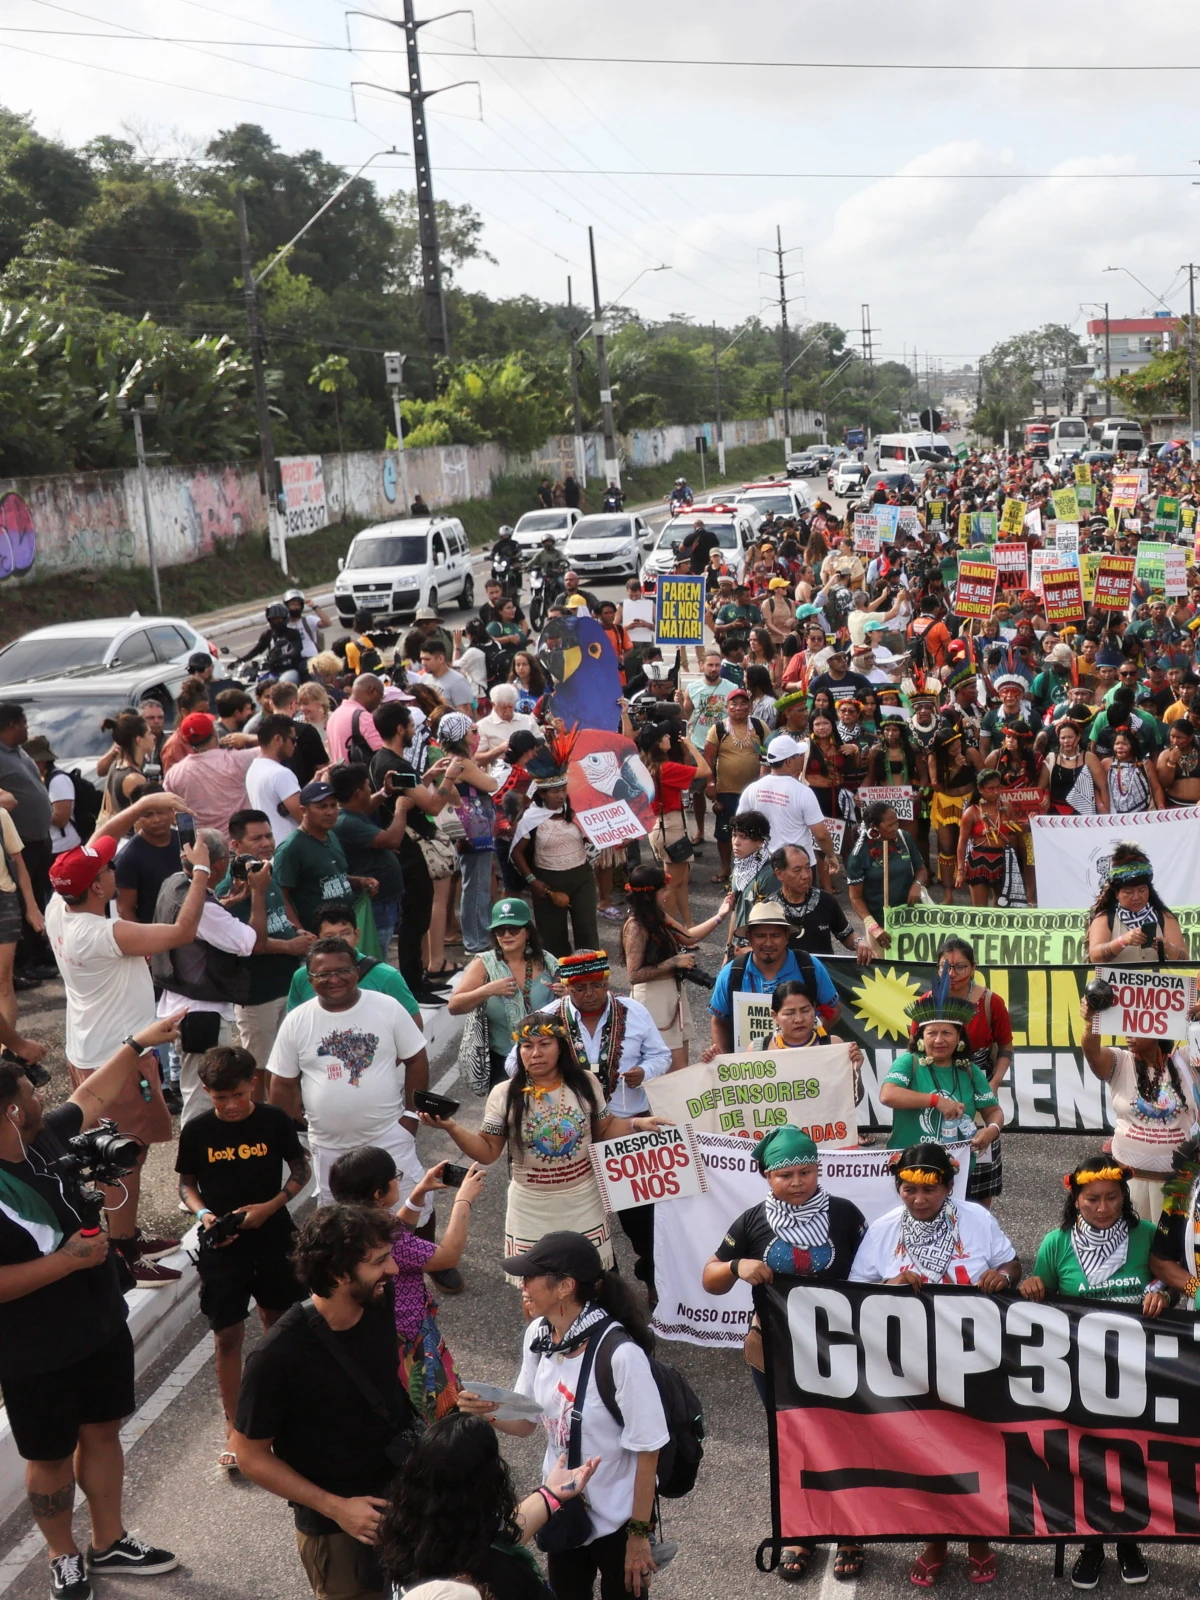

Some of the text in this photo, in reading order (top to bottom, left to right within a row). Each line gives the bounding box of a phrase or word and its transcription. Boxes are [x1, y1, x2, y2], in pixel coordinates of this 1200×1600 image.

[1114, 486, 1136, 495] WE ARE
[1060, 506, 1076, 516] IS US
[1163, 502, 1176, 512] WE
[1154, 518, 1178, 526] NATURE
[1058, 542, 1077, 550] SOMOS
[995, 550, 1026, 564] MAKE
[960, 564, 996, 580] CLIMATE
[1101, 559, 1134, 572] CLIMATE
[998, 571, 1024, 589] PAY
[1043, 571, 1080, 585] CLIMATE
[1137, 568, 1165, 580] GENTE
[960, 582, 992, 597] WE ARE
[1098, 576, 1130, 589] WE ARE
[662, 582, 701, 601] PAREM
[970, 595, 979, 603] THE
[1046, 588, 1079, 601] WE ARE
[956, 602, 991, 615] ANSWER
[1095, 596, 1129, 606] ANSWER
[662, 601, 700, 620] DE NOS
[1047, 605, 1082, 619] ANSWER
[659, 620, 702, 640] MATAR!
[1000, 790, 1040, 802] MAZÔNIA
[583, 805, 627, 827] O FUTURO
[593, 823, 641, 845] INDÍGENA
[1107, 971, 1185, 990] A RESPOSTA
[1109, 984, 1185, 1012] SOMOS
[750, 1018, 774, 1030] FREE
[1122, 1005, 1168, 1035] NÓS
[718, 1060, 777, 1082] SOMOS
[686, 1077, 821, 1119] DEFENSORES
[719, 1108, 788, 1132] DE LAS
[604, 1131, 684, 1160] A RESPOSTA
[605, 1142, 690, 1183] SOMOS
[701, 1152, 746, 1172] NOSSO
[826, 1162, 894, 1179] ORIGINÁ
[630, 1165, 681, 1203] NÓS
[677, 1302, 718, 1323] NOSSO
[787, 1285, 1181, 1423] COP30:
